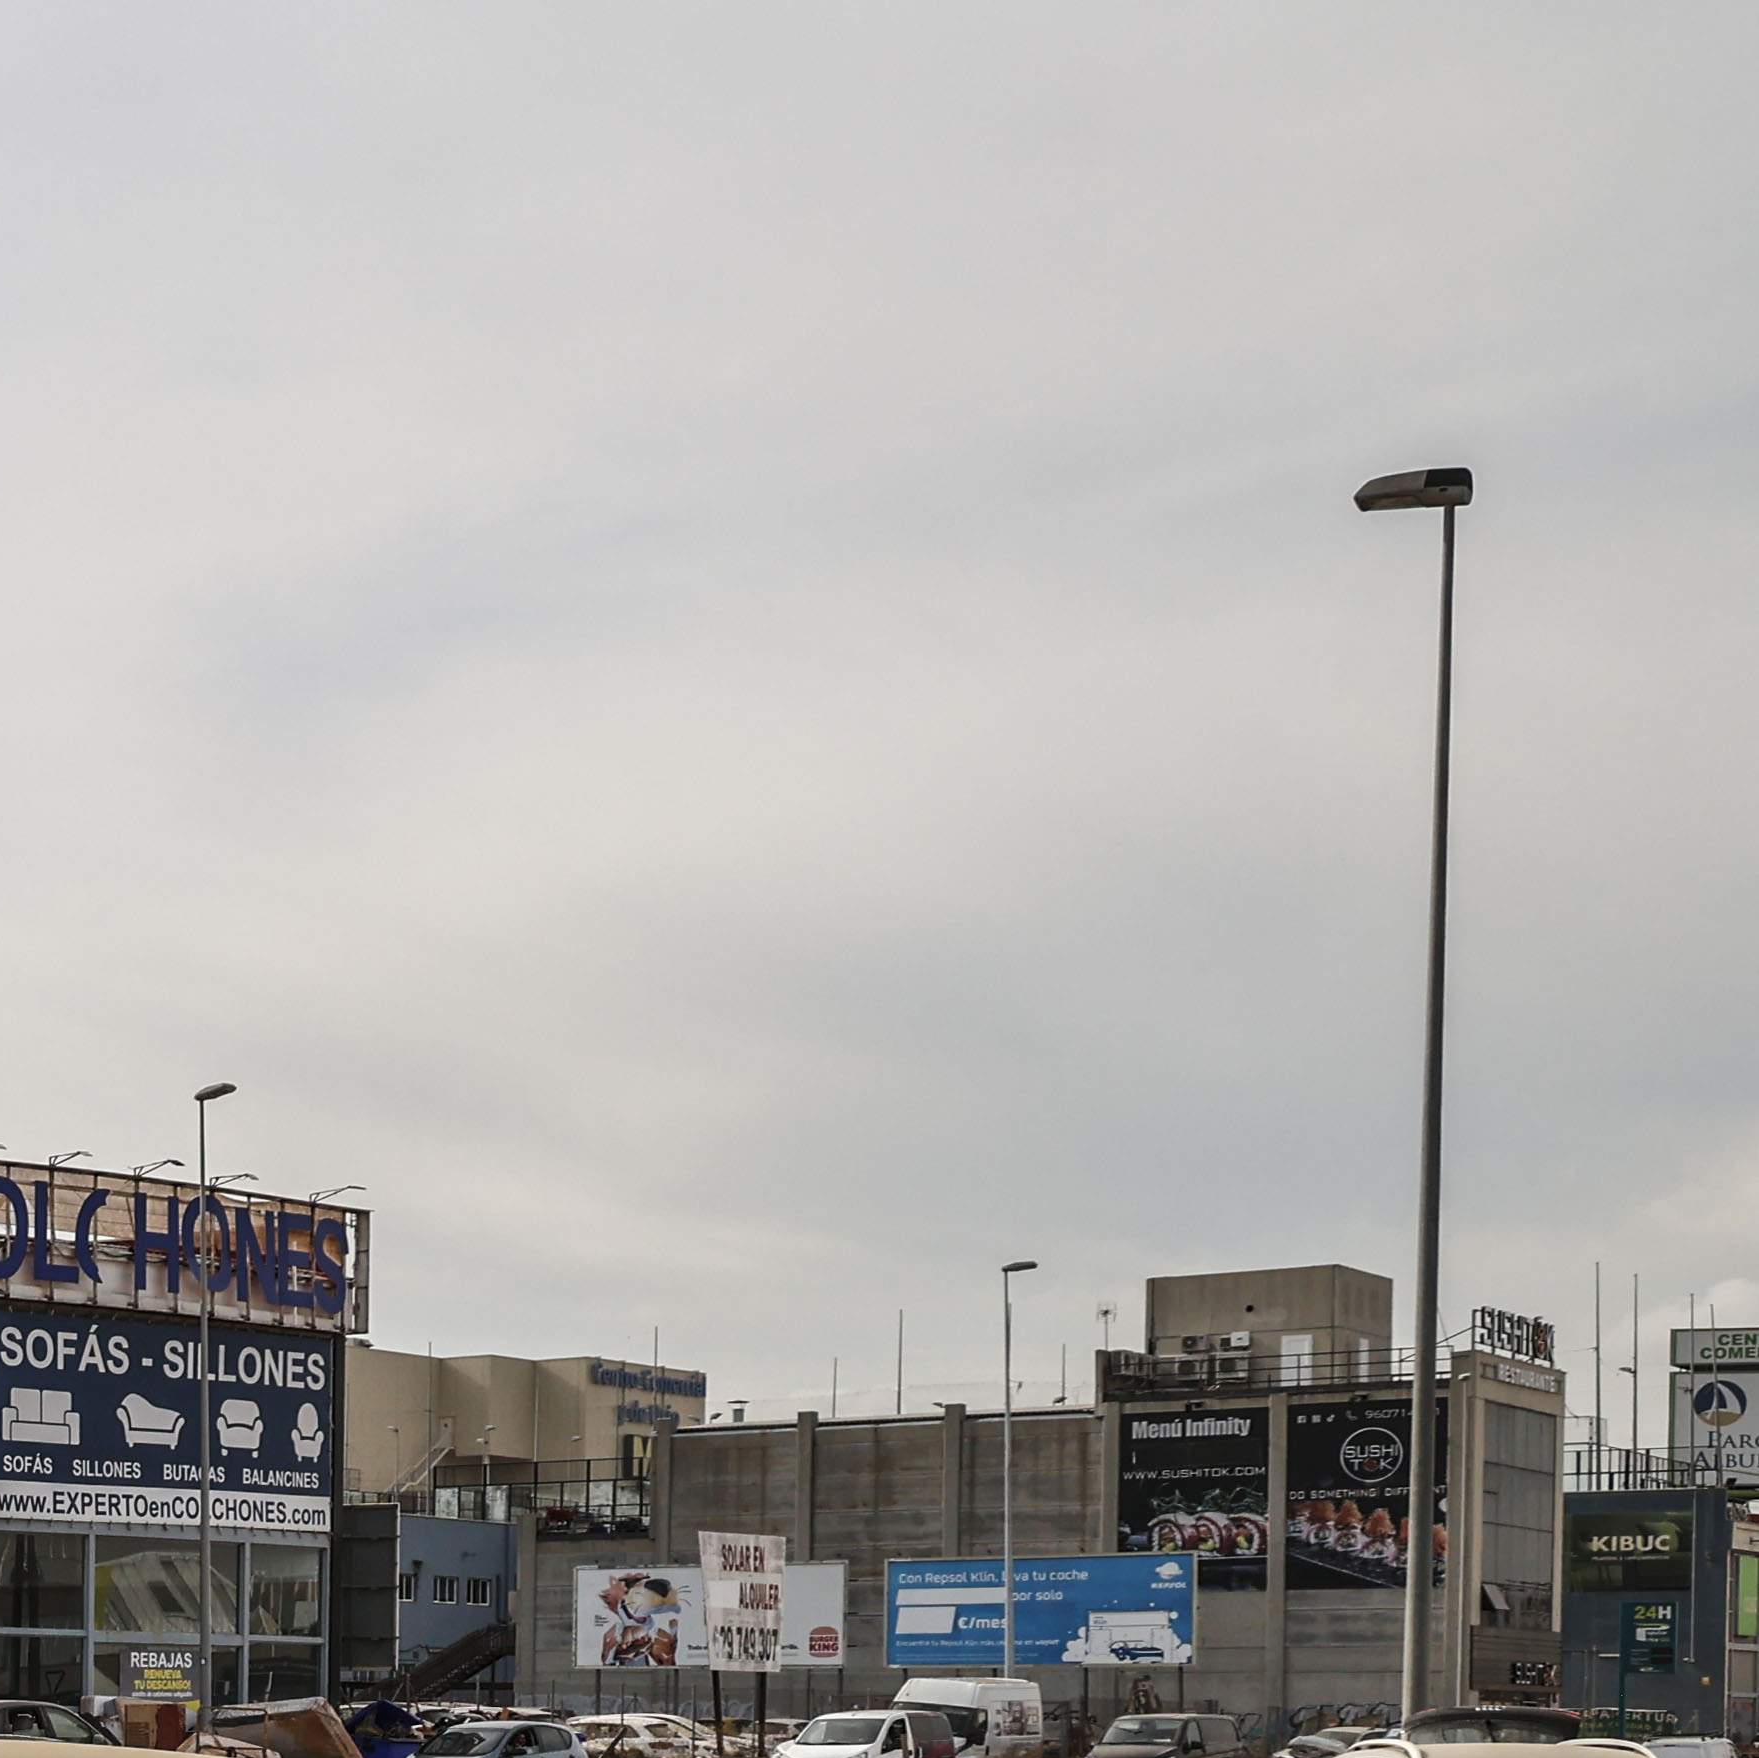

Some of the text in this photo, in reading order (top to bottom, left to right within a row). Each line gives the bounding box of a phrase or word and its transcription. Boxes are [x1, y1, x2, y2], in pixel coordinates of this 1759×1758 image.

[0, 1324, 131, 1375] SOFÁS
[162, 1340, 326, 1391] SILLONES
[1132, 1415, 1252, 1440] Menú Infinity
[1343, 1443, 1399, 1459] SUSHI
[3, 1452, 53, 1475] SOFÁS
[72, 1459, 142, 1479] SILLONES
[242, 1467, 320, 1489] BALANCINES
[1591, 1534, 1671, 1551] KIBUC
[721, 1543, 766, 1573] SOLAR EN
[899, 1573, 921, 1585] Con
[925, 1572, 967, 1586] Repsol
[1032, 1570, 1046, 1581] tu
[1050, 1569, 1089, 1580] coche
[738, 1581, 779, 1610] ALQUILER
[1036, 1589, 1064, 1601] solo
[1634, 1605, 1673, 1620] 24H
[809, 1643, 839, 1653] KING
[130, 1651, 193, 1669] REBAJAS
